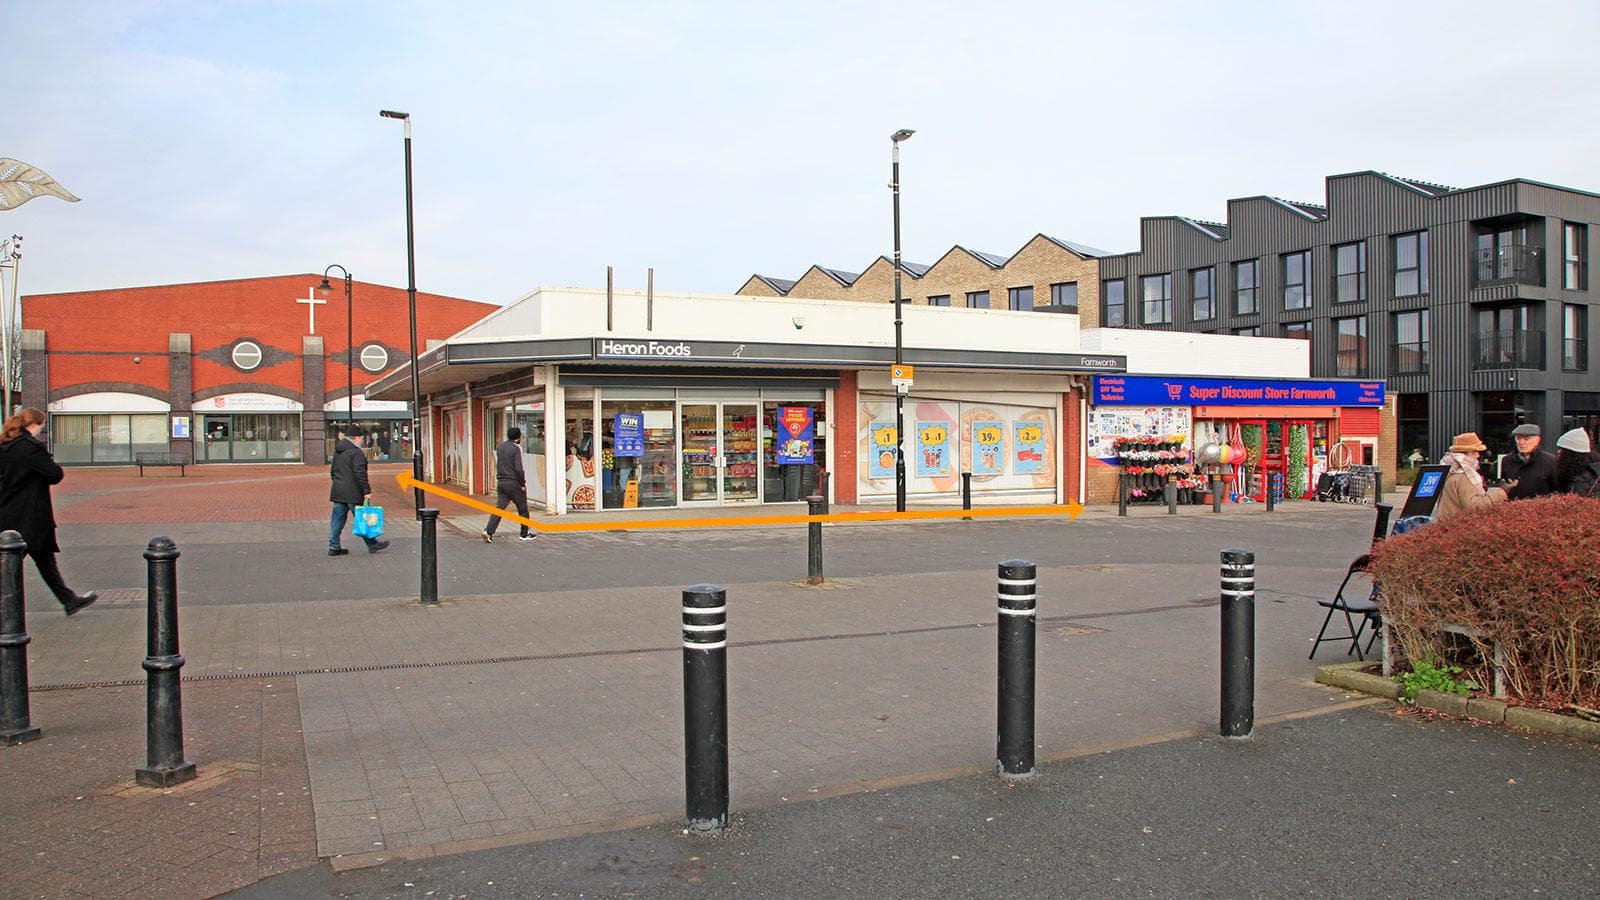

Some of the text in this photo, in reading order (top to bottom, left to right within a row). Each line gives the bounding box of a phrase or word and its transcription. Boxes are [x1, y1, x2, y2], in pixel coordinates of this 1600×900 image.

[601, 339, 691, 356] Heron Foods
[1081, 357, 1117, 367] Farnworth
[1189, 385, 1335, 401] Super Discount Store Farnworth
[620, 417, 638, 427] WIN
[1423, 475, 1439, 486] JW
